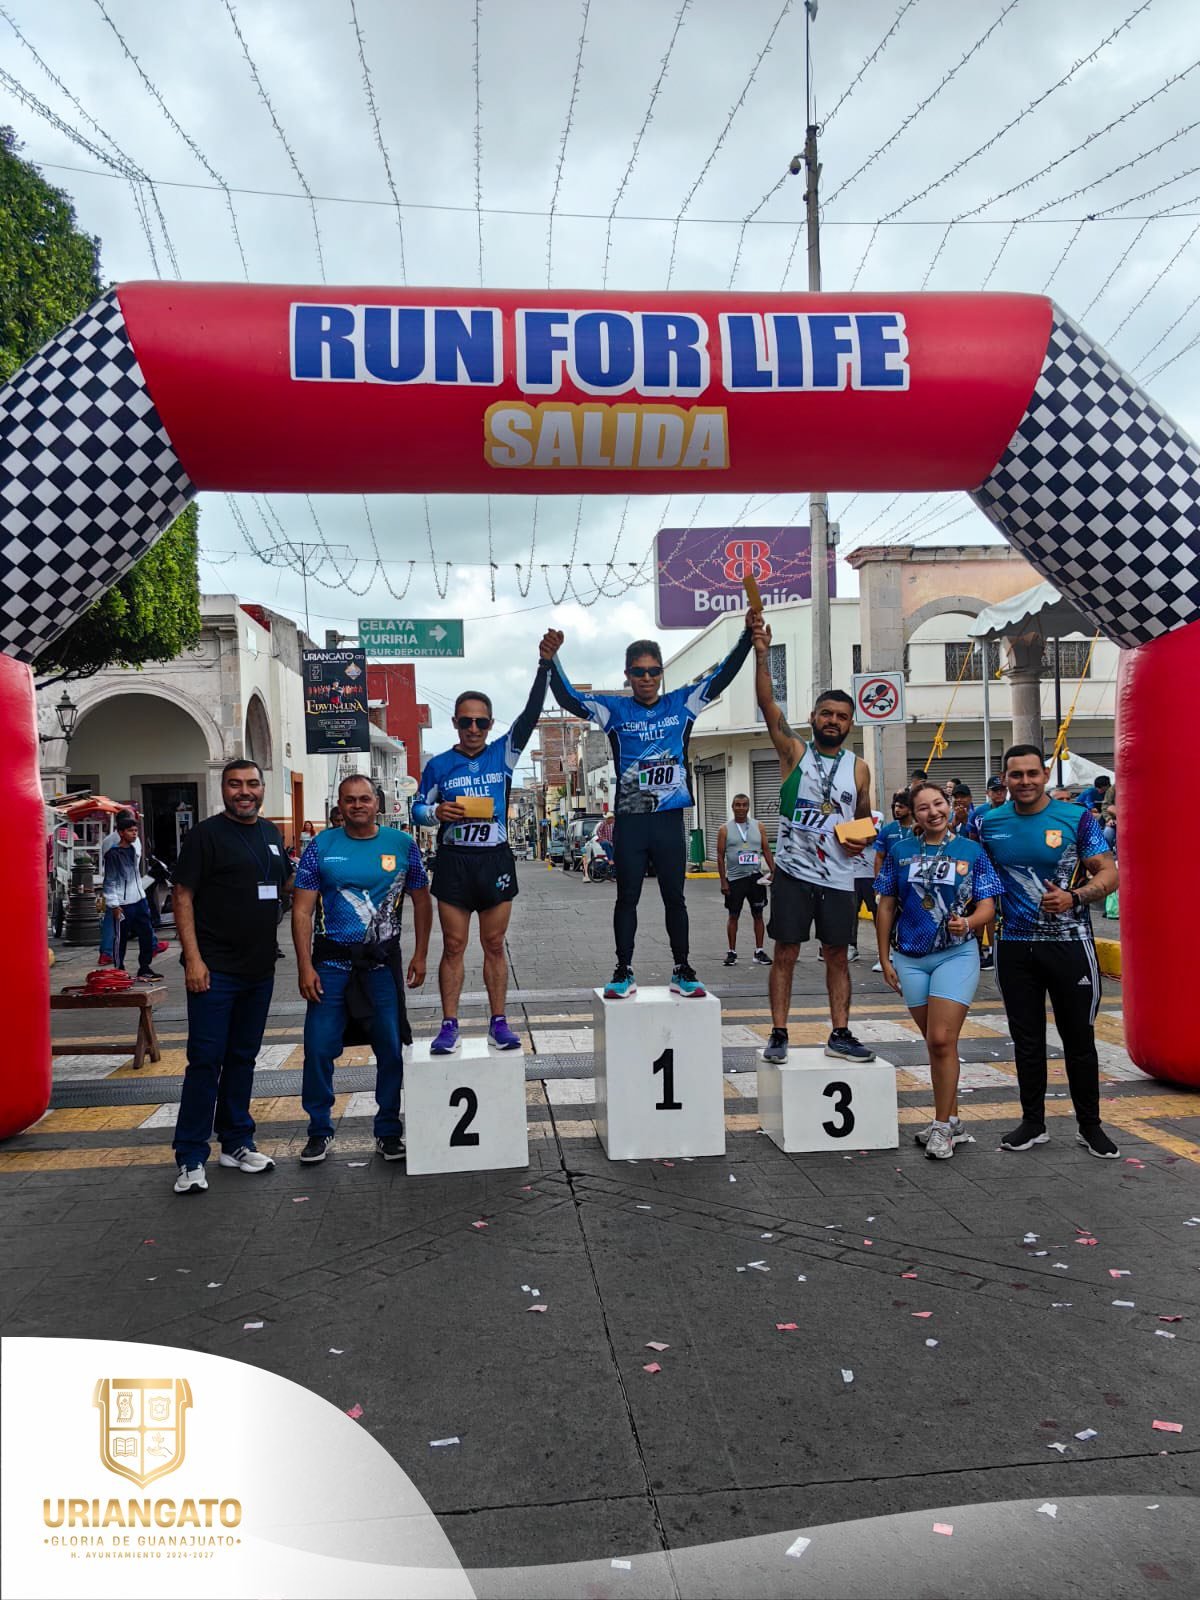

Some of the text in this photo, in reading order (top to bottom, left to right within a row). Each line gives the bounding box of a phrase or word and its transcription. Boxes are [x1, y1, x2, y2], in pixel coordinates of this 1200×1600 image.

[293, 304, 905, 390] RUN FOR LIFE
[489, 407, 727, 468] SALIDA
[360, 620, 415, 631] CELAYA
[361, 634, 418, 645] YURIRIA
[303, 652, 354, 661] URIANGATO
[365, 648, 453, 656] TSUR-DEPORTIVA
[639, 729, 665, 742] VALLE
[444, 775, 472, 790] LEGION
[481, 772, 504, 785] LOBOS
[647, 766, 674, 785] 180
[463, 786, 491, 797] VALLE
[463, 824, 491, 843] 179
[652, 1048, 683, 1111] 1
[448, 1087, 480, 1147] 2
[821, 1081, 856, 1139] 3
